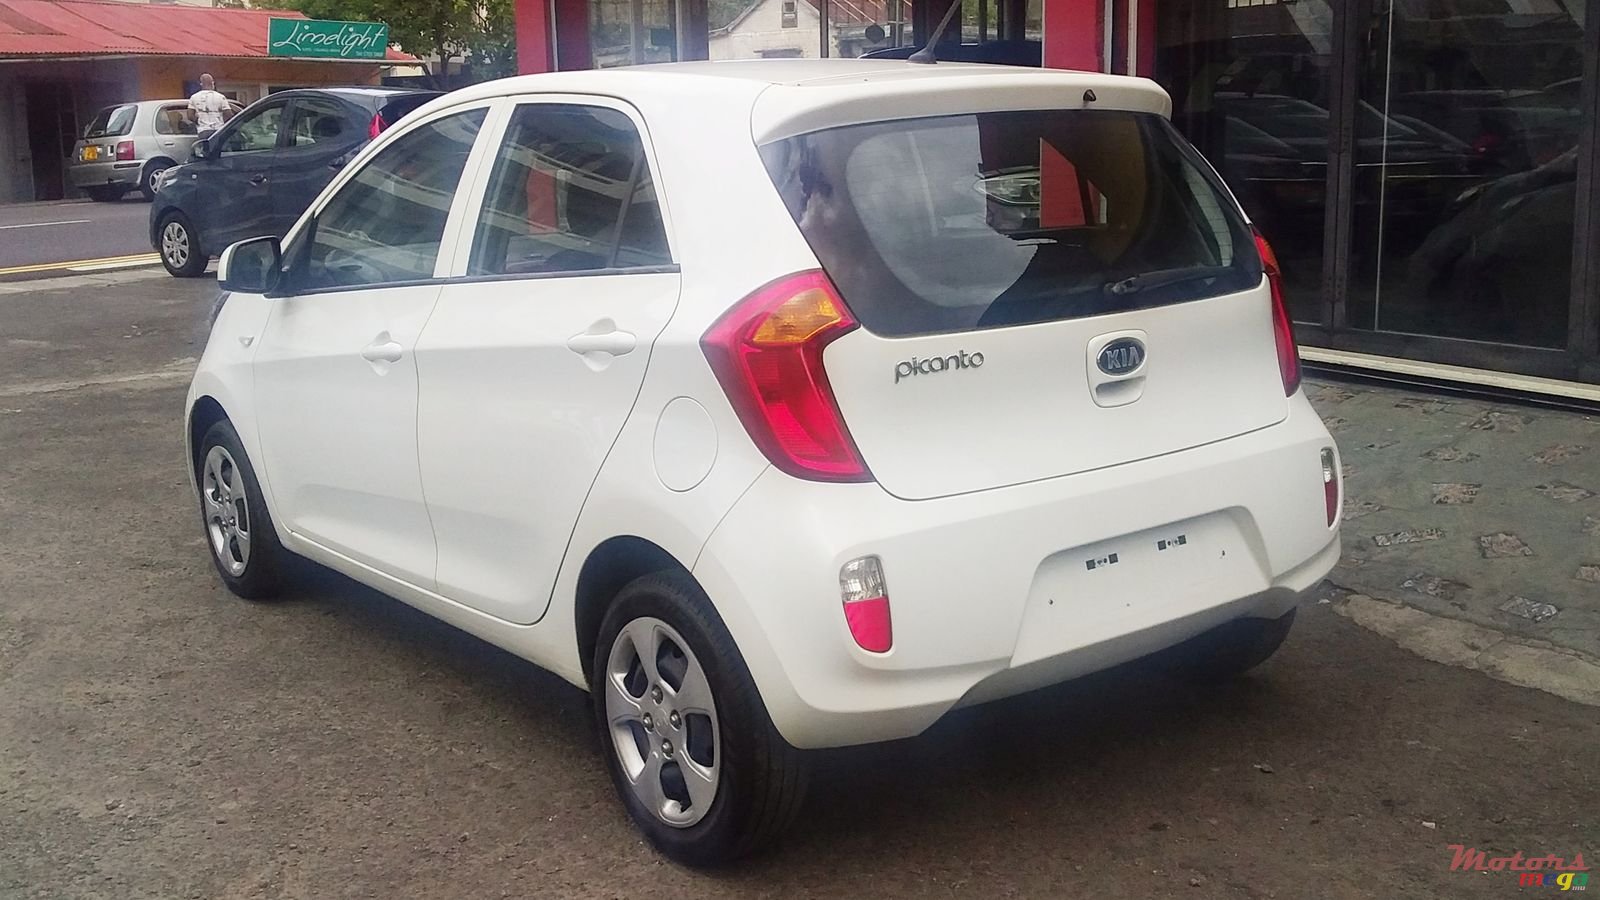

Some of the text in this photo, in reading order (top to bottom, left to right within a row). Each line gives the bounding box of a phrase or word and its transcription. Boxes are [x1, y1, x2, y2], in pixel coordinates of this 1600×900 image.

[273, 21, 385, 56] Limelight
[895, 350, 985, 384] picanto
[1106, 346, 1141, 370] KIA
